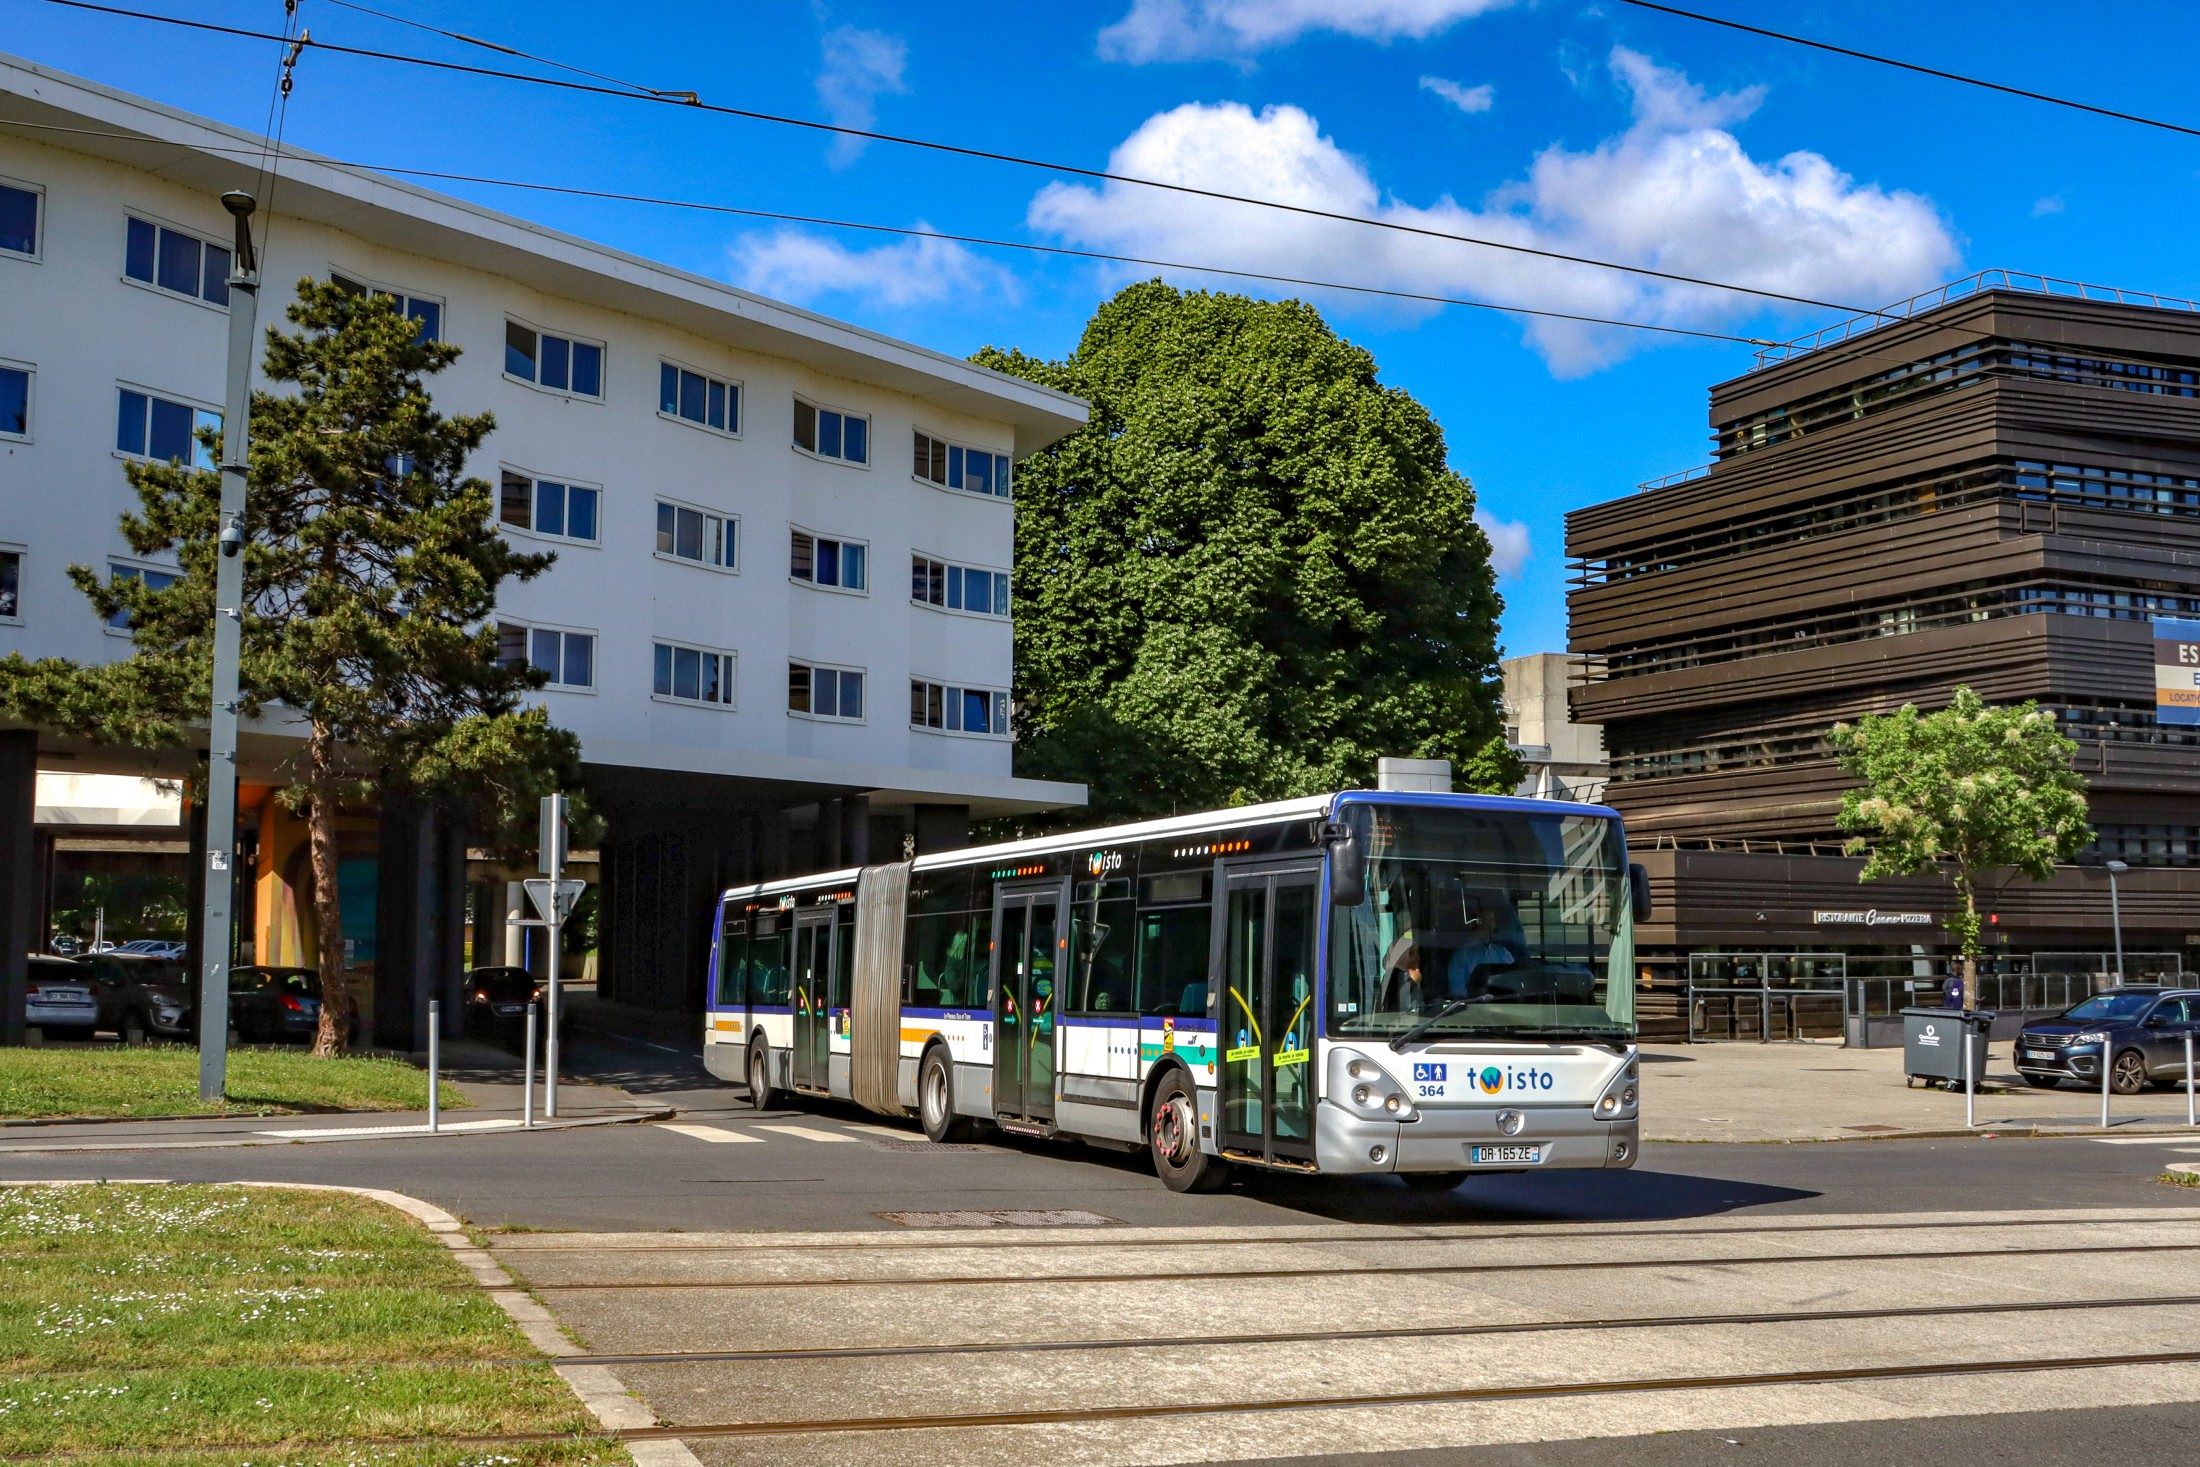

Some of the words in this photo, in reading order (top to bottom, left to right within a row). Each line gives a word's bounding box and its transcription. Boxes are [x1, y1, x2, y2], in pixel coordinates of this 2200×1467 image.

[1088, 850, 1122, 875] twisto
[1817, 912, 1865, 923] RISTORANTE
[1900, 913, 1933, 924] PIZZERIA
[1467, 1065, 1554, 1095] twisto
[1418, 1085, 1445, 1097] 364
